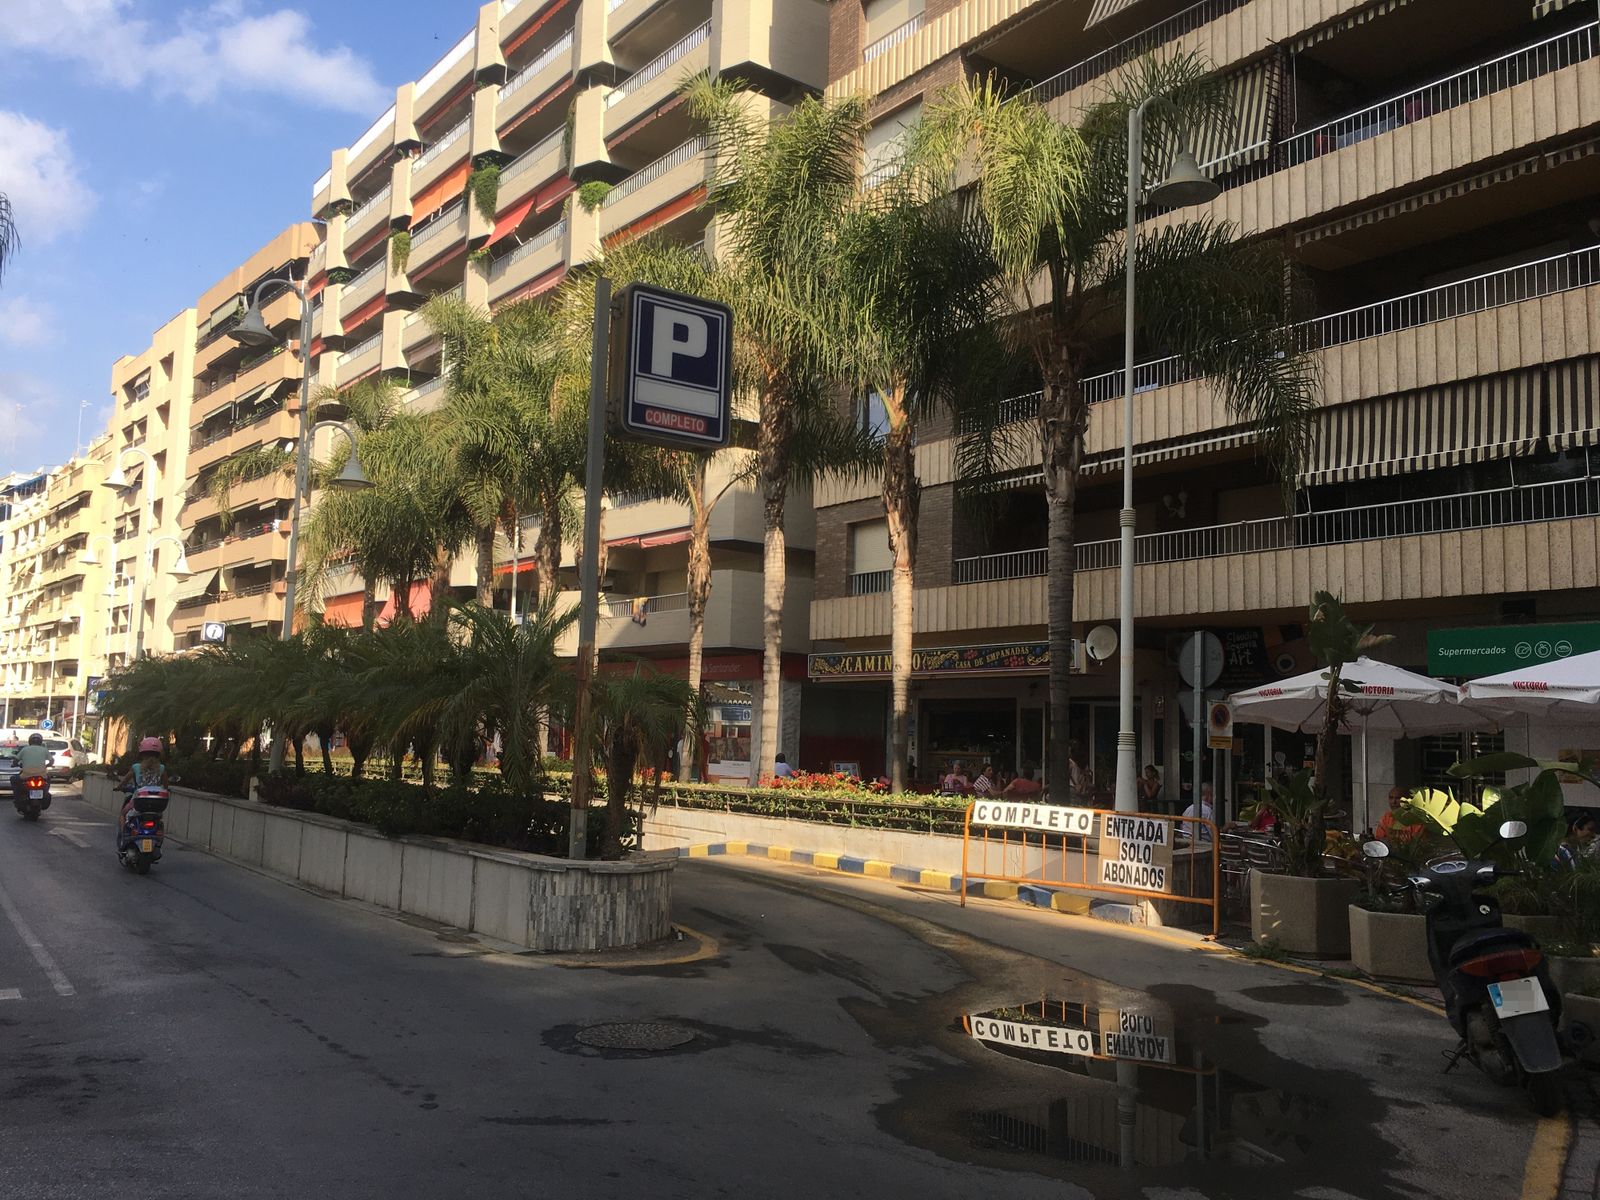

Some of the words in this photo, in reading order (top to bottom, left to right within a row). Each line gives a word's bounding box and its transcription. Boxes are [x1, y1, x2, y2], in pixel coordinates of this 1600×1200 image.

[651, 305, 708, 377] P
[645, 410, 705, 432] COMPLETO
[955, 660, 972, 669] CASA
[974, 657, 984, 667] DE
[986, 646, 1030, 663] EMPANADAS
[1230, 649, 1254, 666] Art
[1438, 645, 1507, 658] Supermercados
[1258, 687, 1283, 697] VICTORIA
[1360, 685, 1395, 695] VICTORIA
[1512, 681, 1549, 691] VICTORIA
[977, 804, 1090, 831] COMPLETO
[1105, 816, 1165, 844] ENTRADA
[1120, 841, 1152, 864] SOLO
[1103, 861, 1165, 889] ABONADOS
